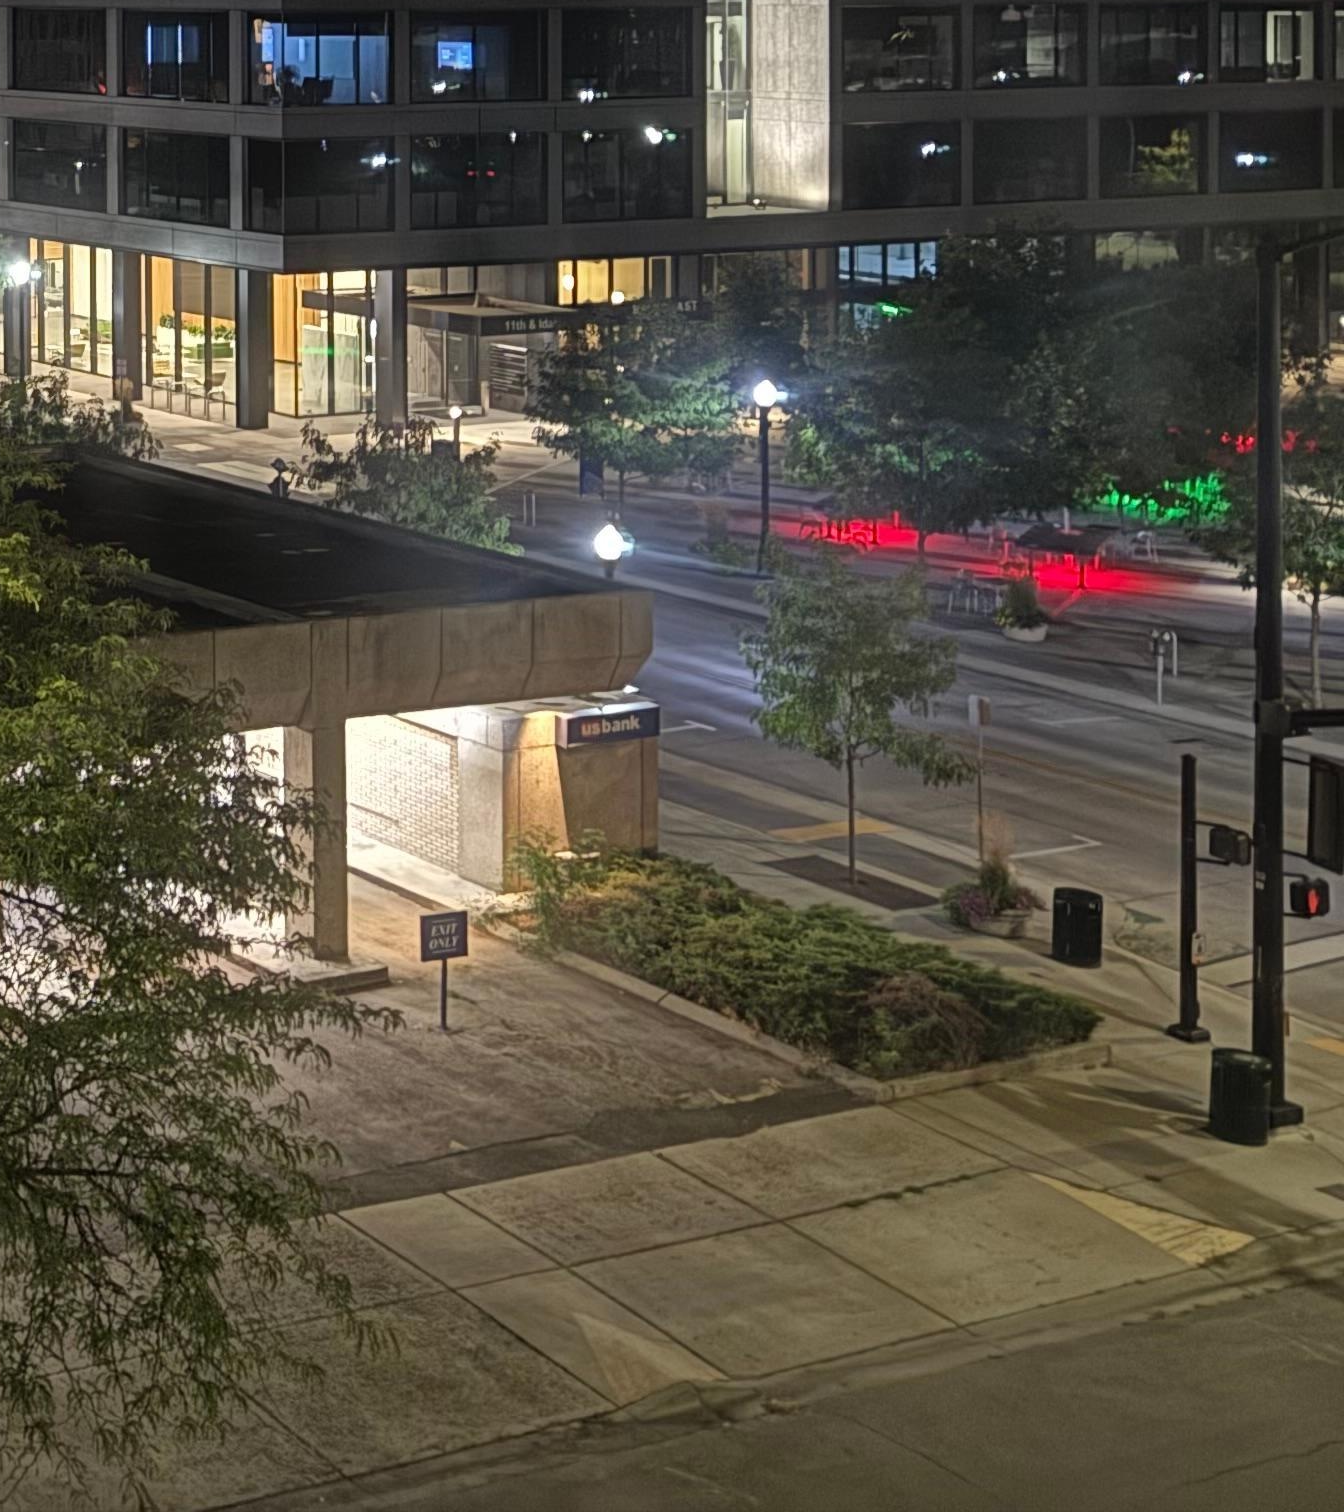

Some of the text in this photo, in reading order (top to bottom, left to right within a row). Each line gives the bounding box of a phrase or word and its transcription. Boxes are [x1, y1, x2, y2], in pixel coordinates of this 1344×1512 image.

[504, 319, 527, 332] 11th
[529, 318, 536, 330] &
[431, 923, 458, 937] EXIT
[429, 935, 459, 950] ONLY
